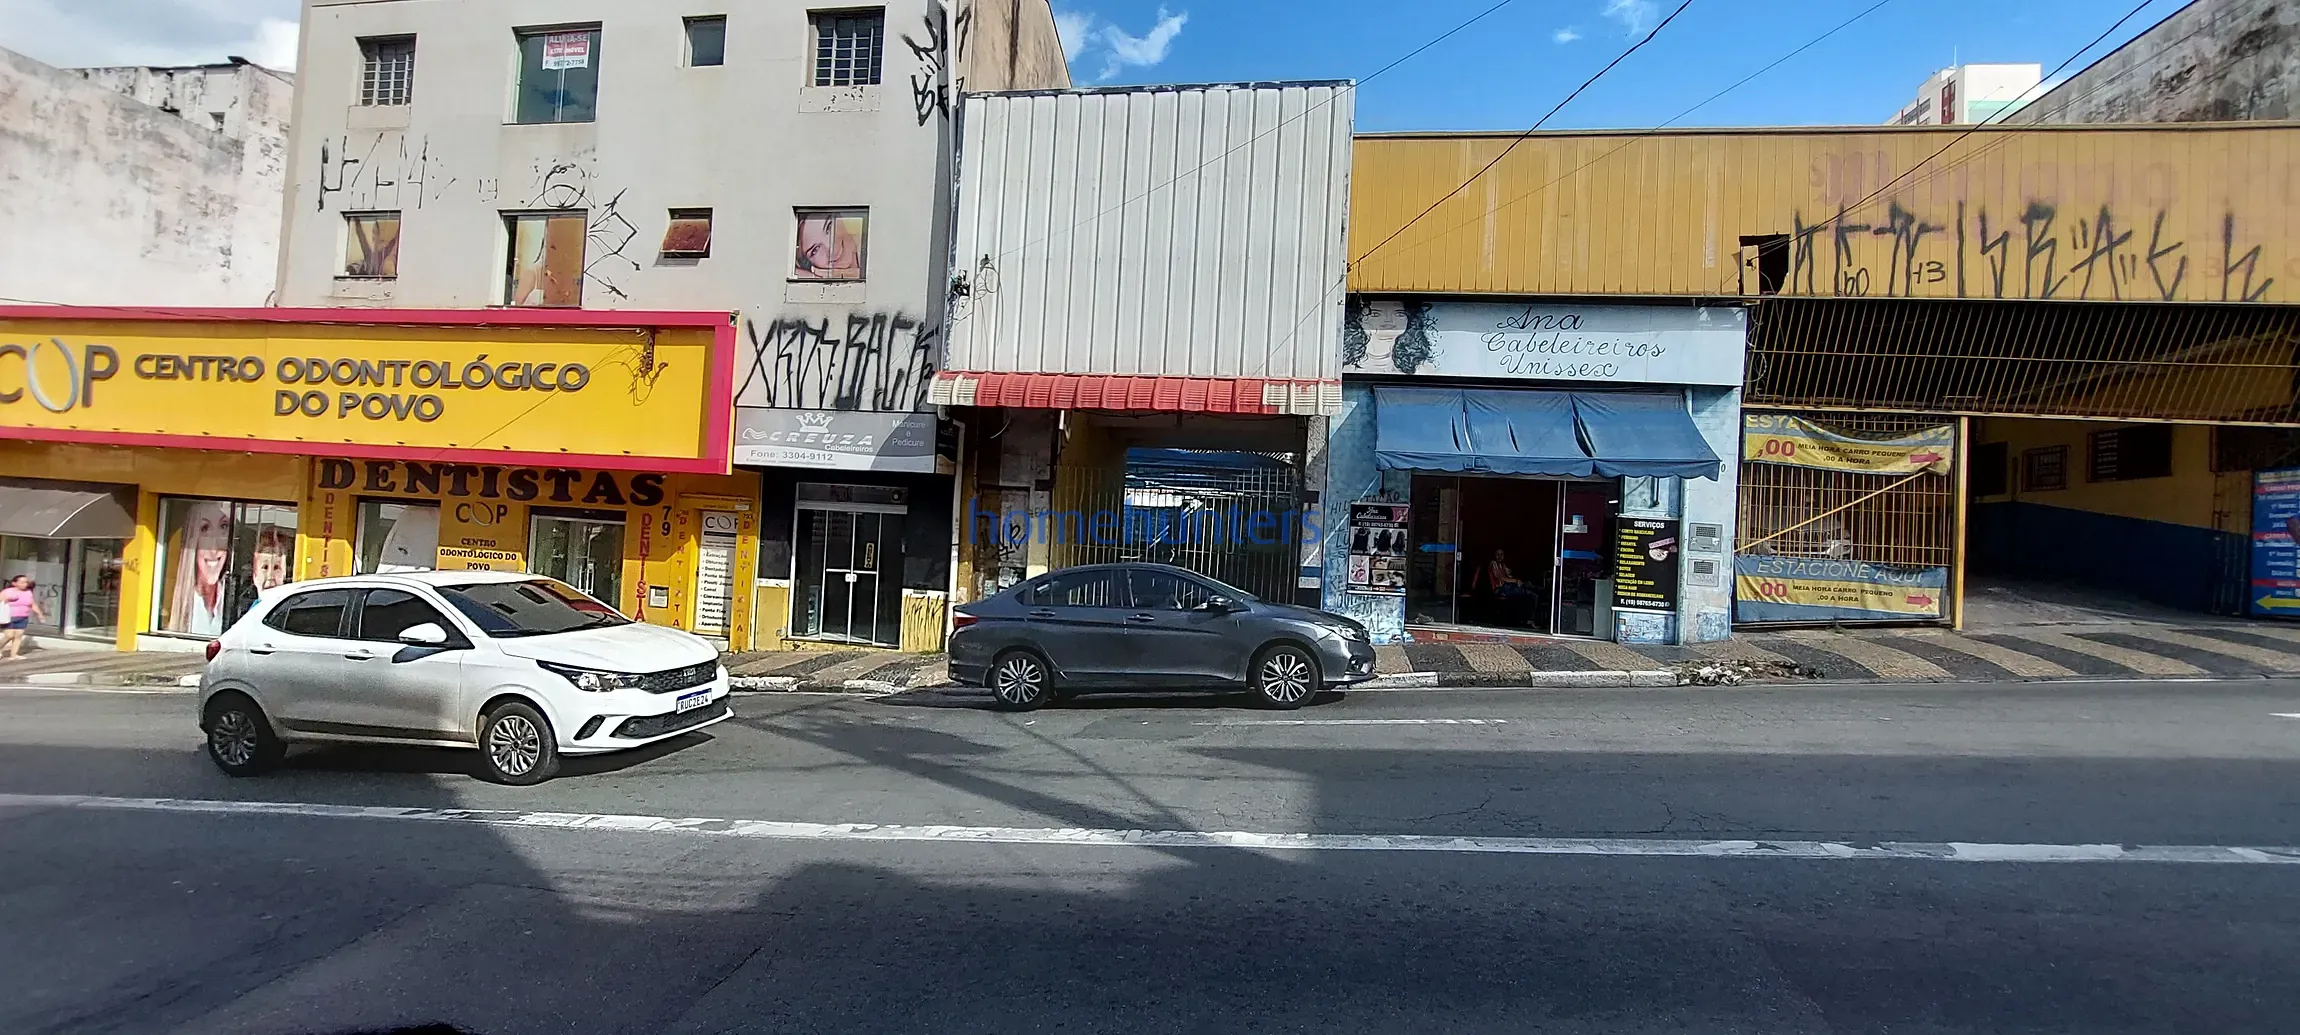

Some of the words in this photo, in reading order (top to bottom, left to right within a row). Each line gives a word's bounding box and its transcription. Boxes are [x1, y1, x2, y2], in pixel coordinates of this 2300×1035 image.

[549, 34, 587, 43] ALUA-SE
[1497, 306, 1584, 330] Ana
[1481, 331, 1666, 357] Cabeleireiros
[1500, 353, 1619, 377] Unissex
[0, 338, 119, 412] COP
[134, 354, 265, 383] CENTRO
[276, 355, 590, 393] ODONTOLÓGICO
[274, 390, 329, 417] DO
[337, 391, 444, 423] POVO
[892, 420, 926, 429] Manicure
[770, 432, 873, 446] CREUZA
[892, 438, 925, 447] Pedicure
[825, 444, 873, 453] Cabeleireiros
[1818, 445, 1841, 453] HORA
[1843, 448, 1870, 456] CARRO
[751, 450, 779, 459] Fone:
[782, 451, 833, 461] 3304-9112
[1846, 457, 1870, 465] HORA
[318, 458, 665, 507] DENTISTAS
[456, 501, 508, 526] COP
[1634, 521, 1665, 529] SERVIÇOS
[461, 538, 496, 547] CENTRO
[467, 562, 490, 570] POVO
[1757, 560, 1870, 579] ESTACIONE
[1860, 589, 1893, 597] PEQUENO
[680, 695, 709, 711] RUC2E24
